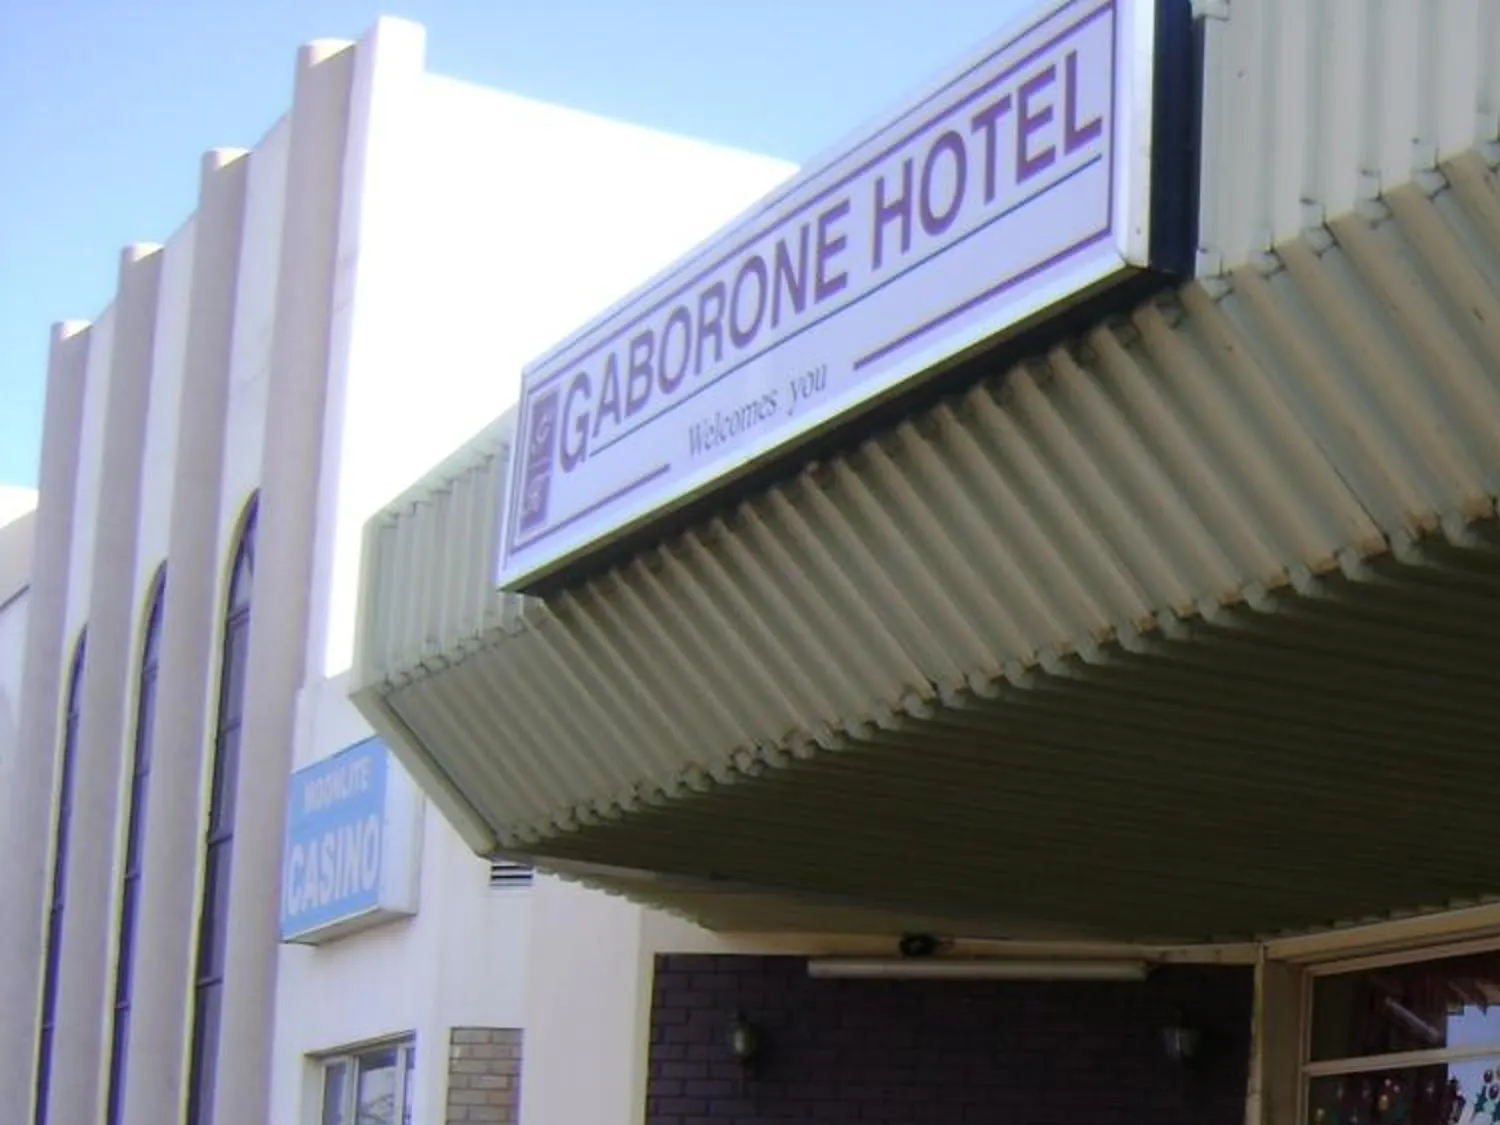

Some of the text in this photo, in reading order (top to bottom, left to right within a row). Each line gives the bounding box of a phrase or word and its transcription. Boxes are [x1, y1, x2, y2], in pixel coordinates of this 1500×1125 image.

[559, 198, 851, 473] GABORONE
[871, 49, 1103, 272] HOTEL
[688, 363, 828, 458] Welcomes you
[287, 813, 380, 916] CASINO
